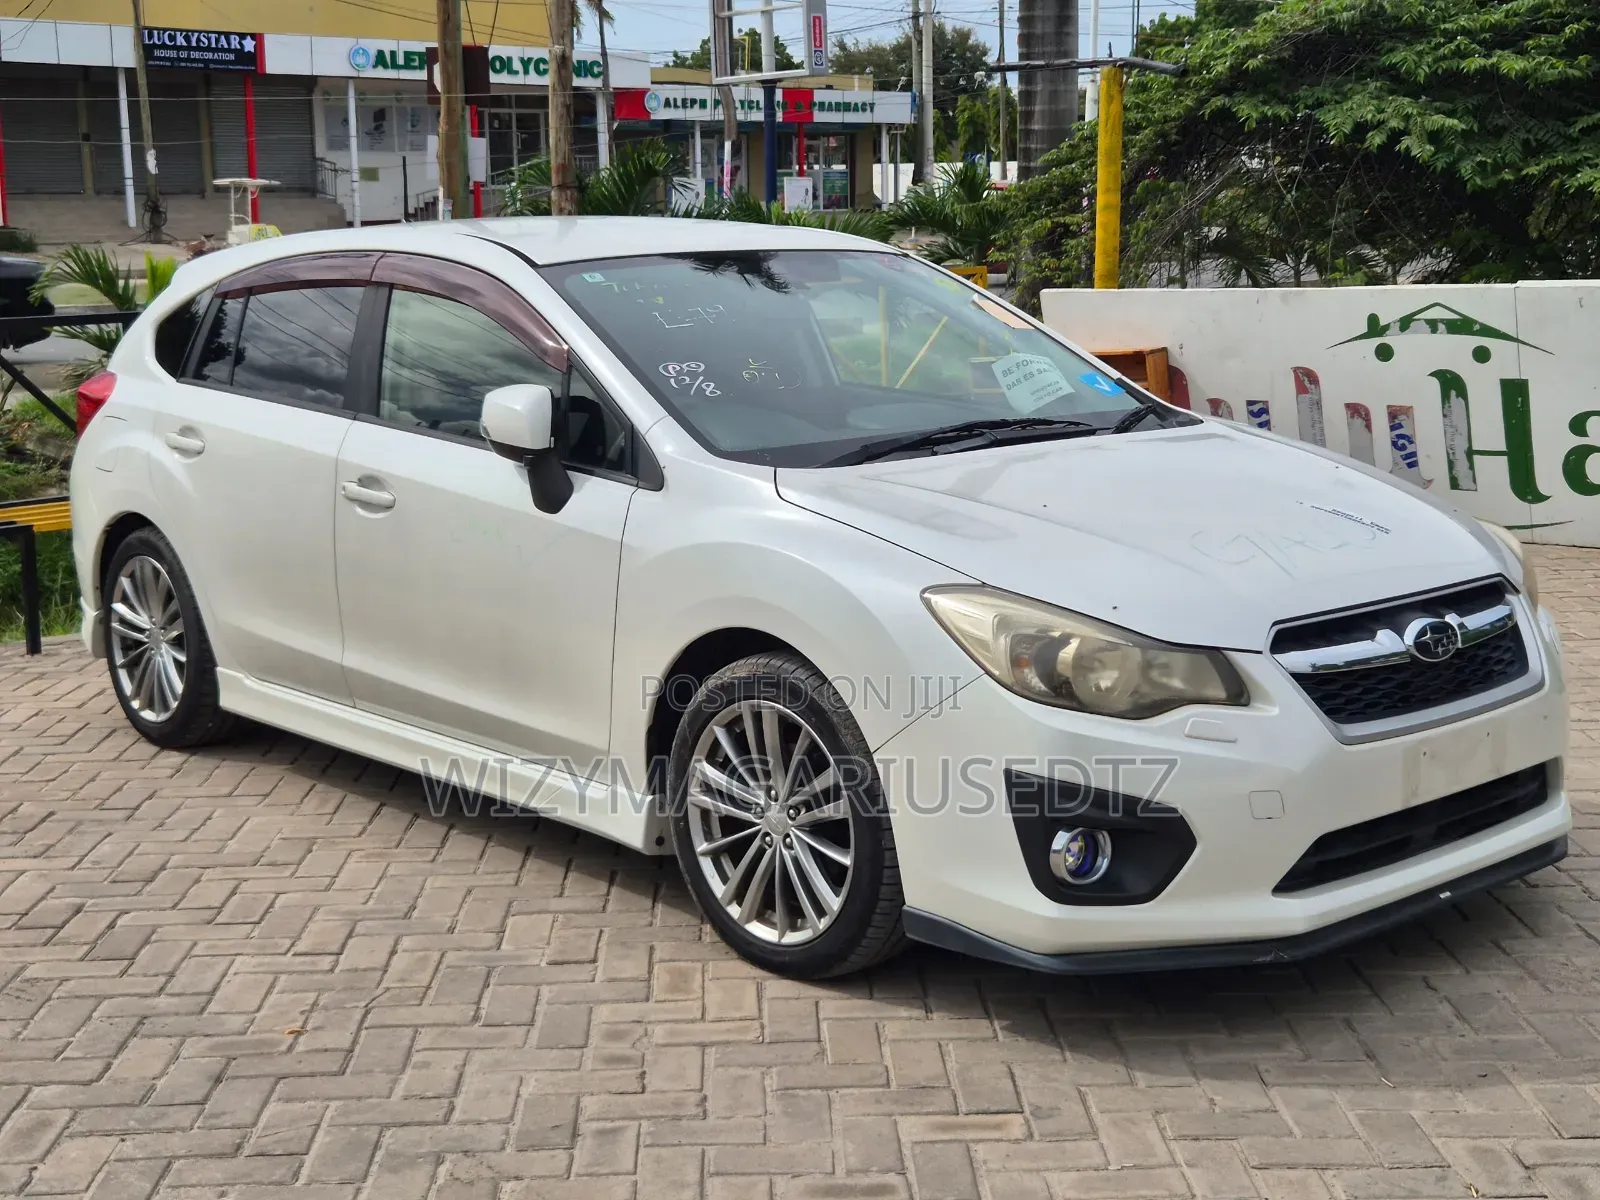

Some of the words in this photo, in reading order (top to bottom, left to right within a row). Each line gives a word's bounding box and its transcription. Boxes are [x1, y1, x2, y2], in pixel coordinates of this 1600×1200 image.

[143, 29, 241, 49] LUCKYSTAR
[154, 49, 177, 58] HOUSE
[190, 51, 235, 60] DECORATION
[372, 49, 427, 70] ALEP
[490, 55, 603, 79] OLYCNIC
[663, 97, 707, 110] ALEPH
[811, 101, 876, 113] PHARMACY
[1001, 366, 1014, 379] BE
[1005, 378, 1022, 391] DAR
[1022, 371, 1035, 382] ES
